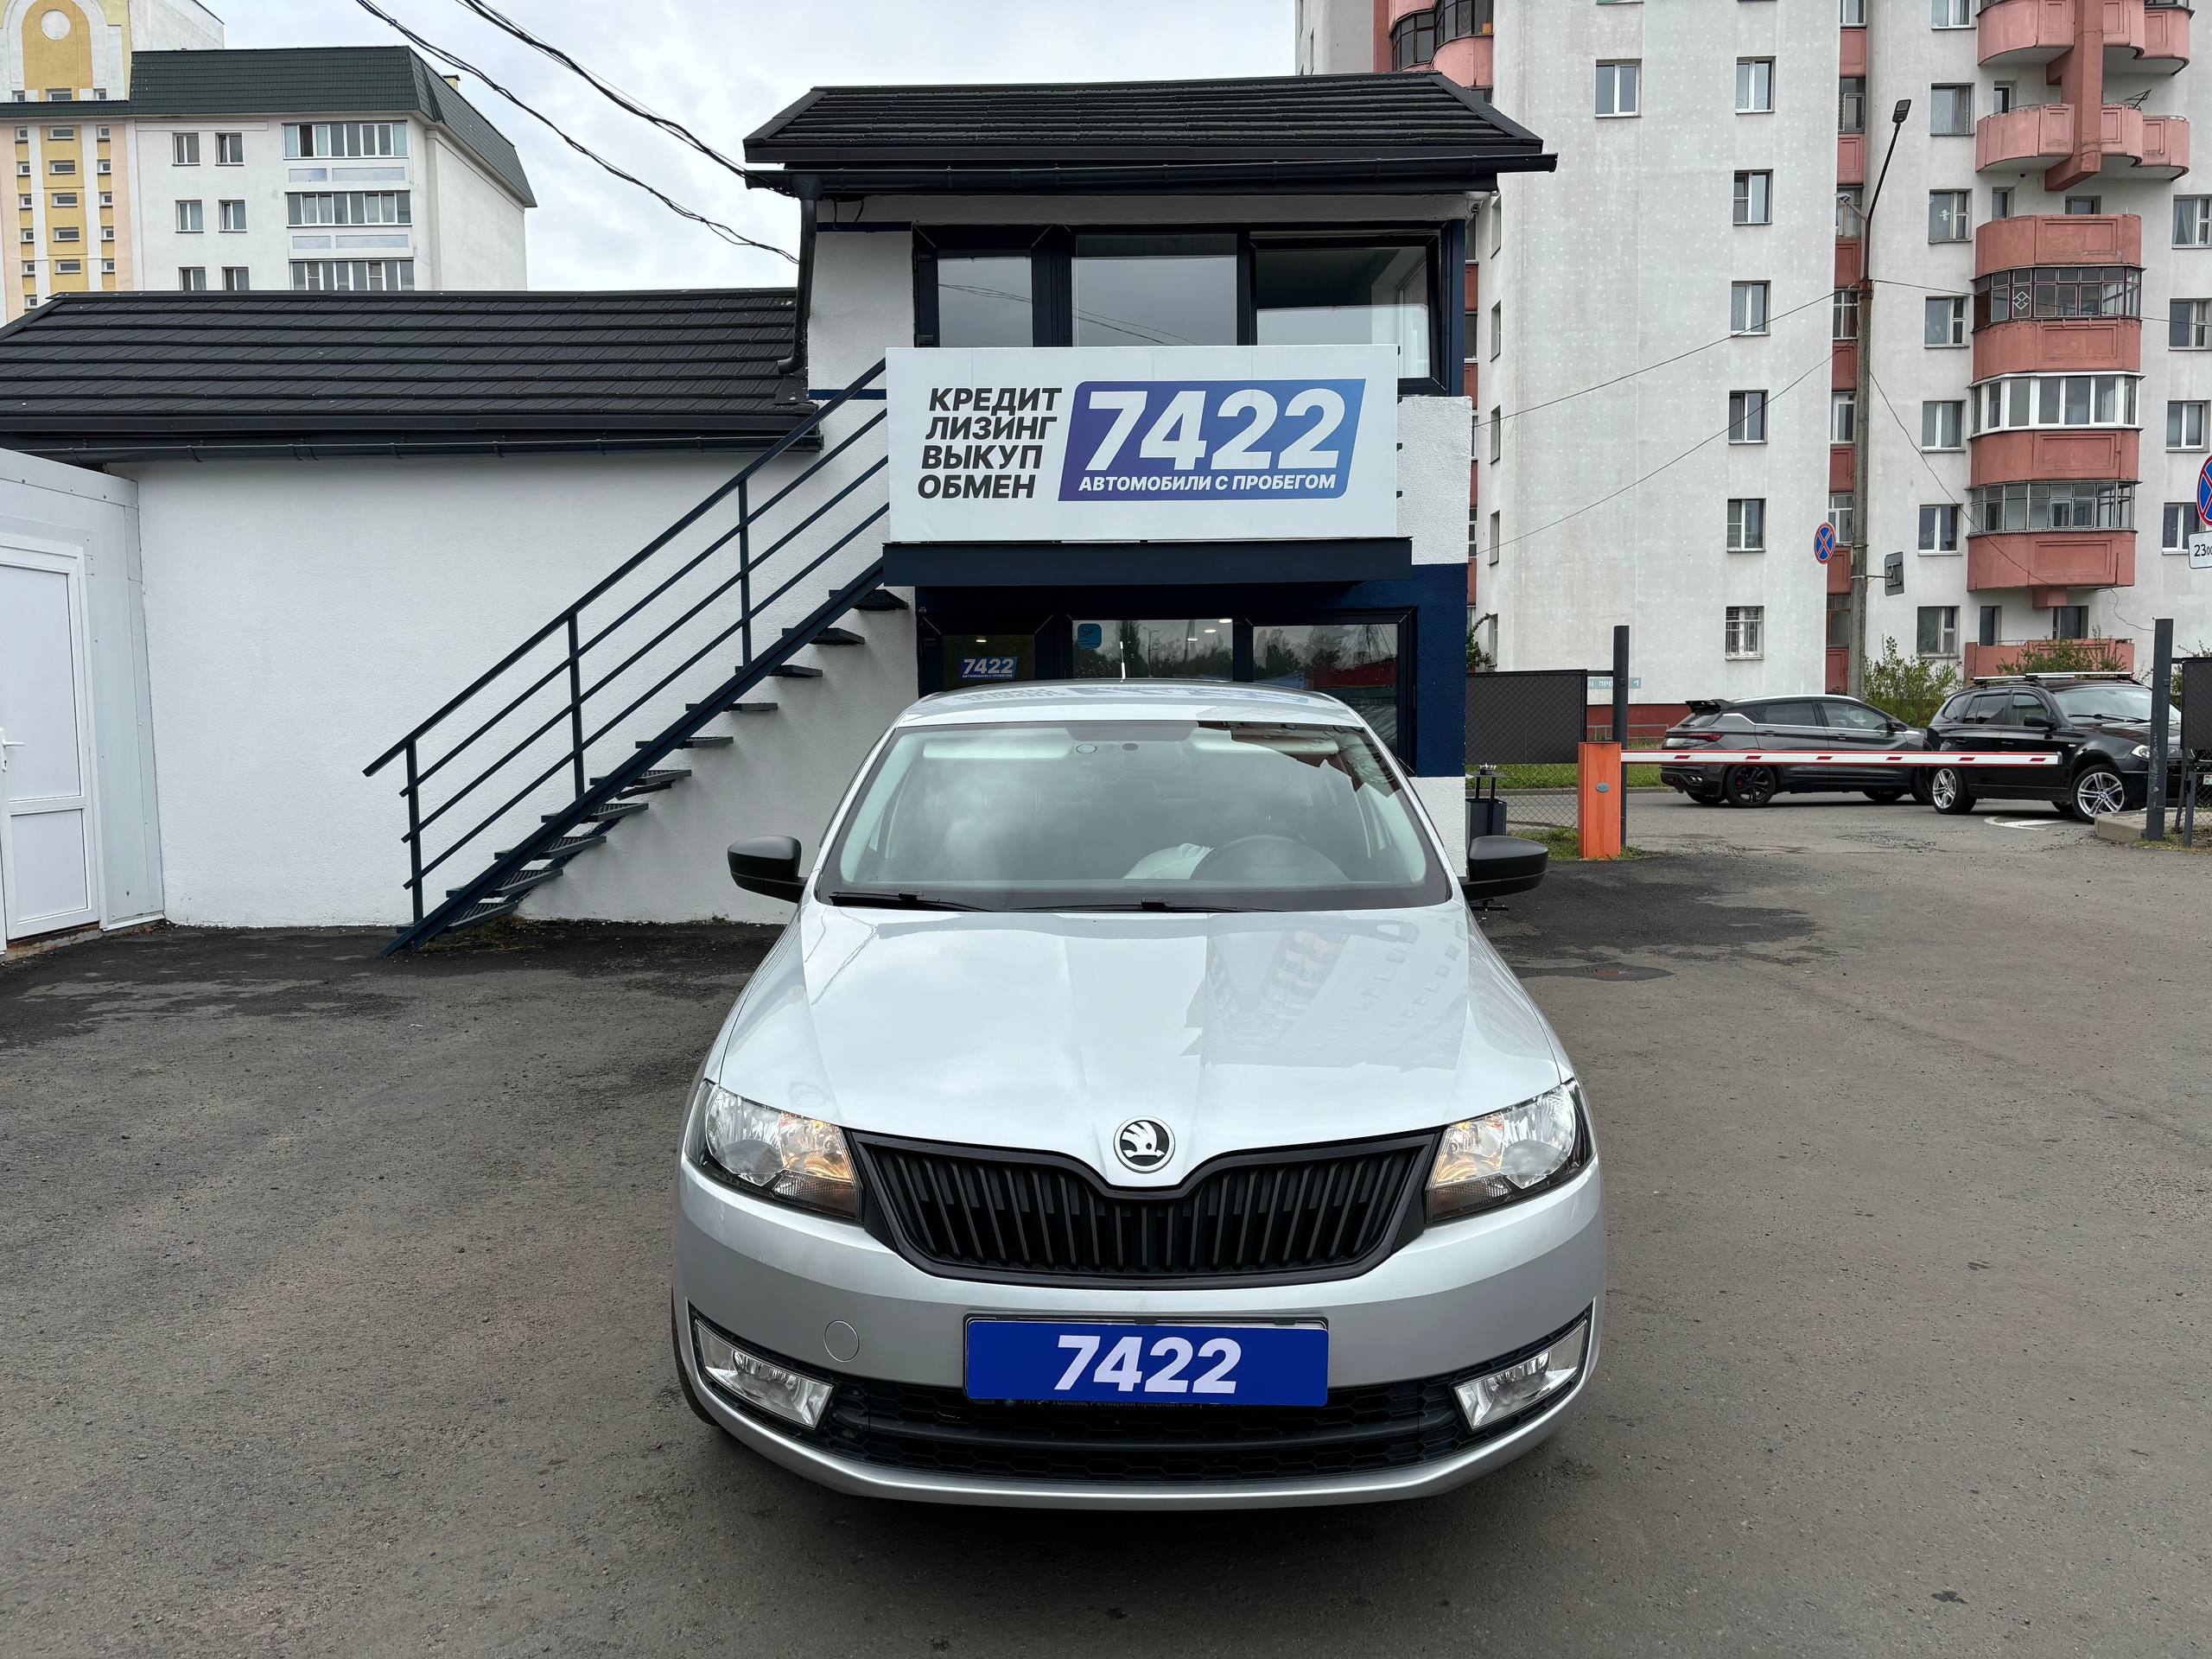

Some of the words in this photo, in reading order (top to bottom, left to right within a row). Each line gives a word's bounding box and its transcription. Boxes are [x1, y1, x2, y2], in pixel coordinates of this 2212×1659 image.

[929, 388, 1063, 416] КРЕДИТ
[925, 416, 1058, 440] ЛИЗИНГ
[1085, 388, 1346, 471] 7422
[921, 445, 1043, 469] ВЫКУП
[918, 474, 1036, 499] ОБМЕН
[1078, 475, 1211, 492] АВТОМОБИЛИ
[1215, 475, 1228, 491] С
[1231, 474, 1337, 490] ПРОБЕГОМ
[963, 658, 1014, 674] 7422
[1053, 1335, 1243, 1394] 7422
